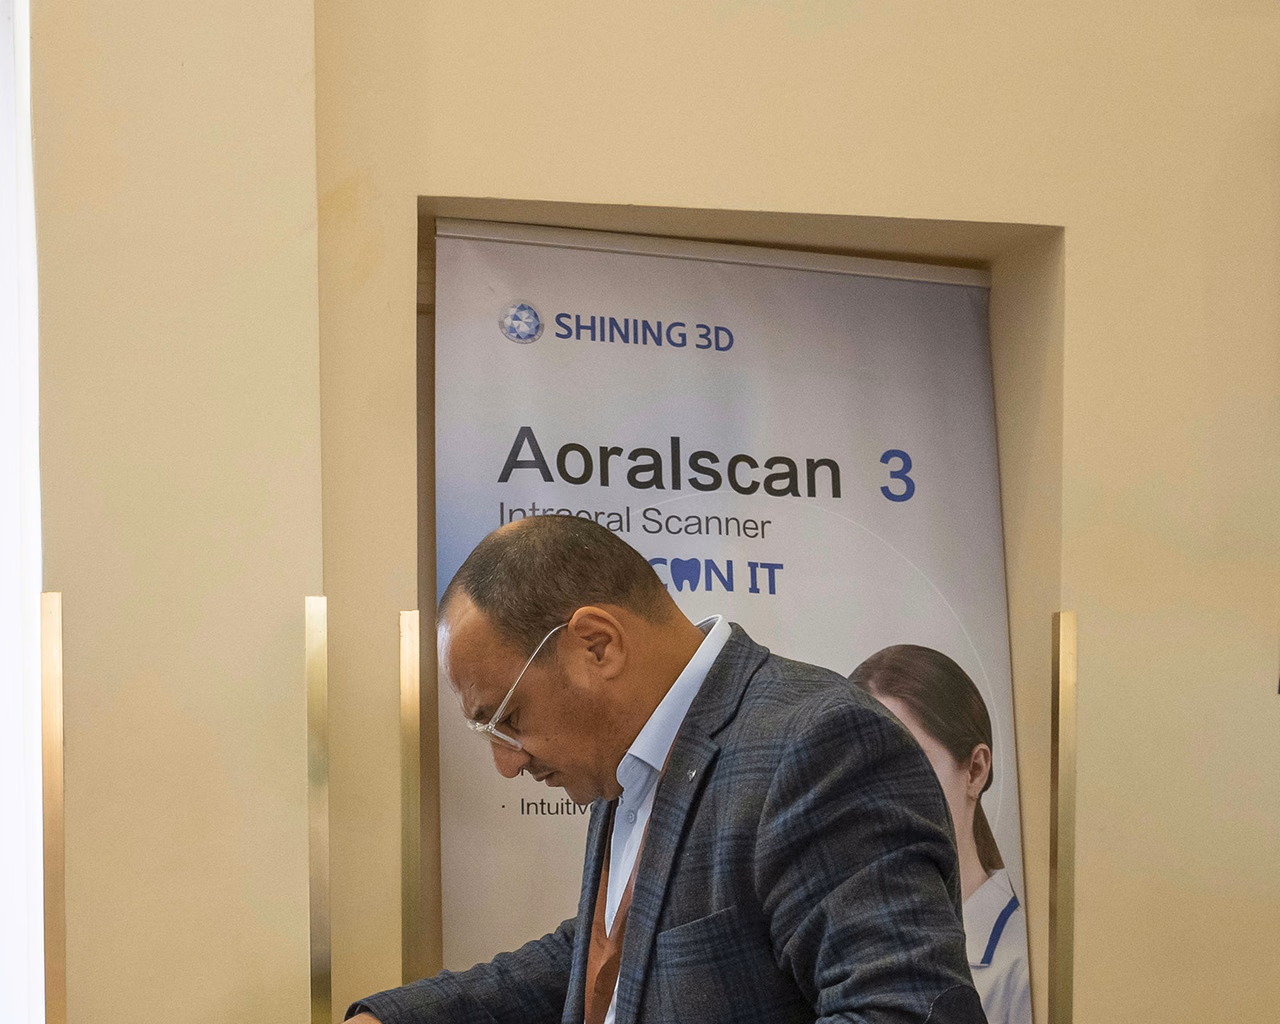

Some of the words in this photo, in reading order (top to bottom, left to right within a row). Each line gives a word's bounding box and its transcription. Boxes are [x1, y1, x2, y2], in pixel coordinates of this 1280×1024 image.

[555, 312, 687, 348] SHINING
[695, 324, 734, 352] 3D
[497, 425, 842, 499] Aoralscan
[879, 448, 916, 502] 3
[499, 502, 631, 533] Intoral
[642, 507, 772, 539] Scanner
[747, 561, 784, 595] IT
[521, 798, 593, 815] Intuitiv
